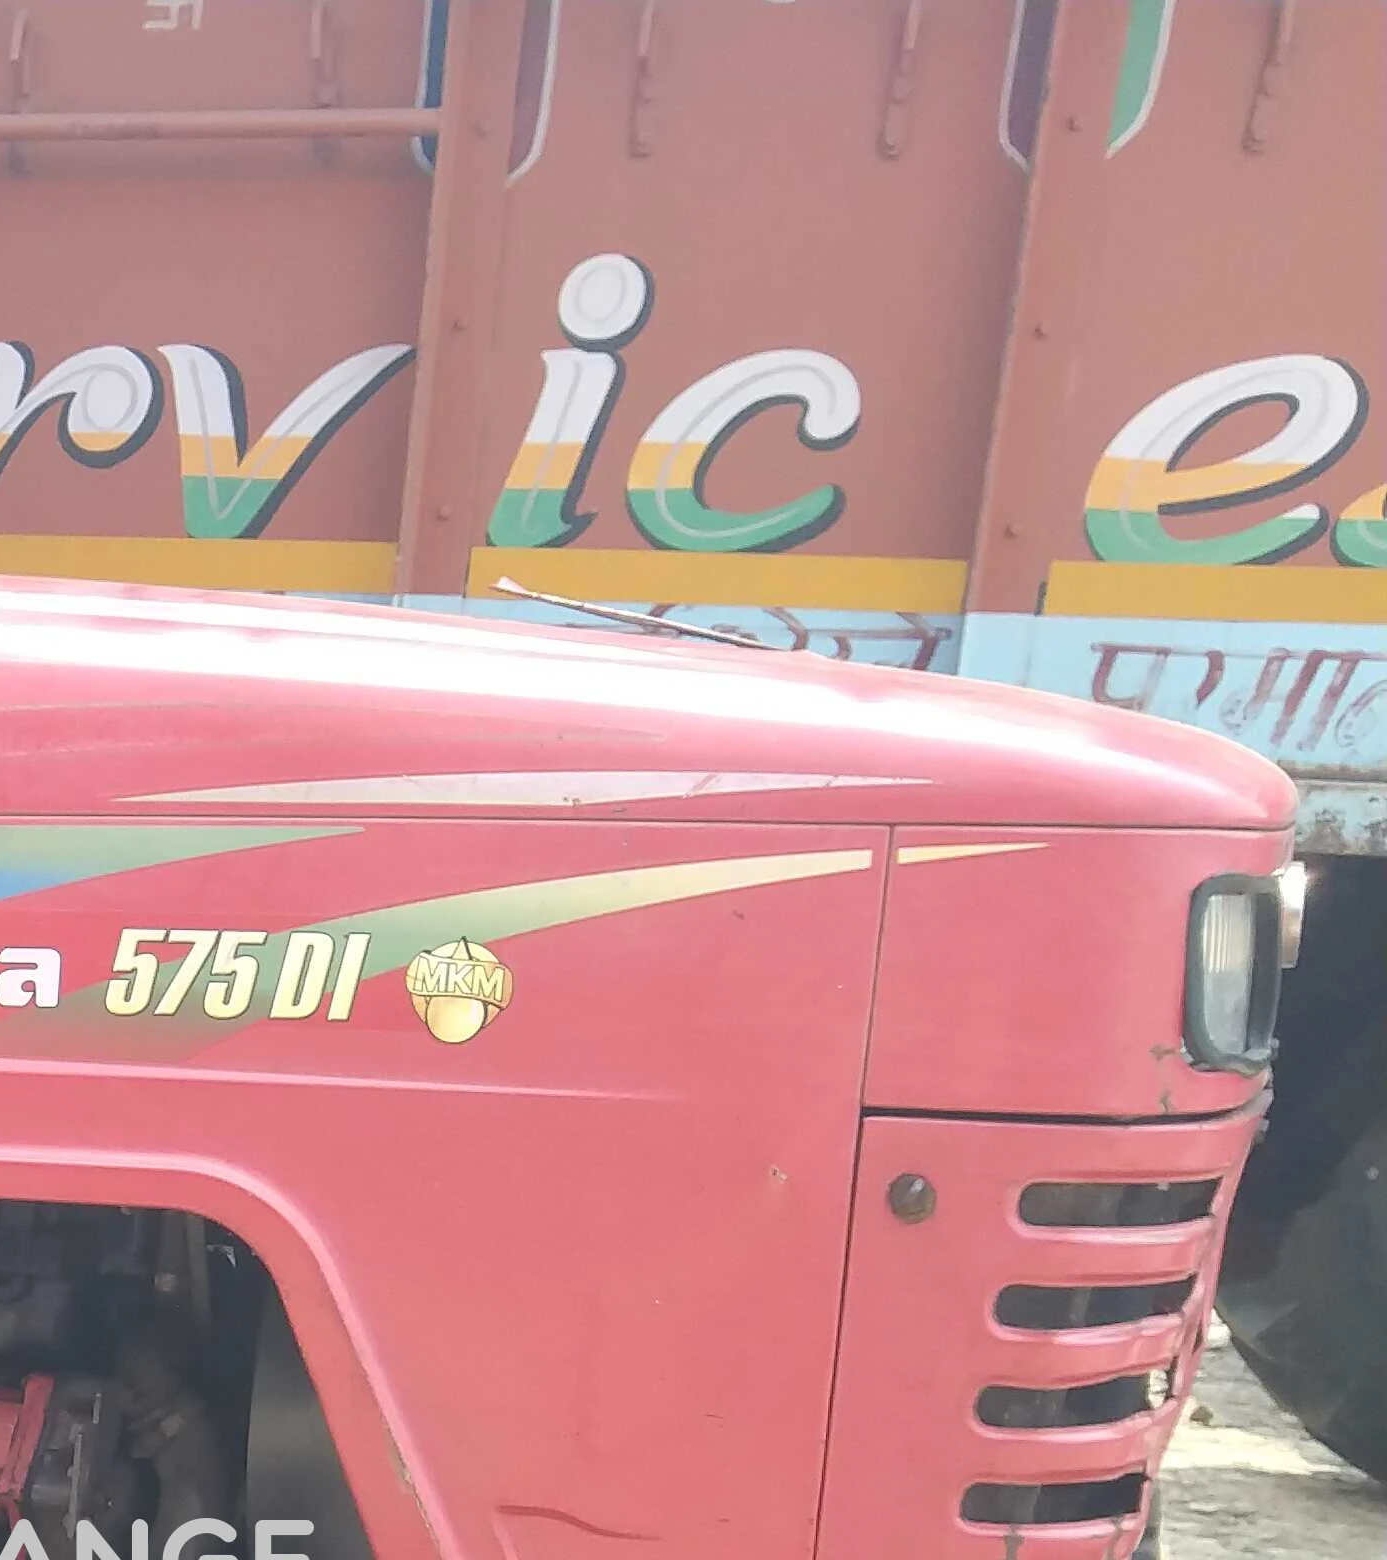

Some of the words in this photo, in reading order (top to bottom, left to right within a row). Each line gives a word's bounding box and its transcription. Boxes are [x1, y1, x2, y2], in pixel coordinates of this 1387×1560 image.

[104, 927, 268, 1020] 575
[269, 931, 372, 1022] DI
[413, 955, 506, 1003] MKM
